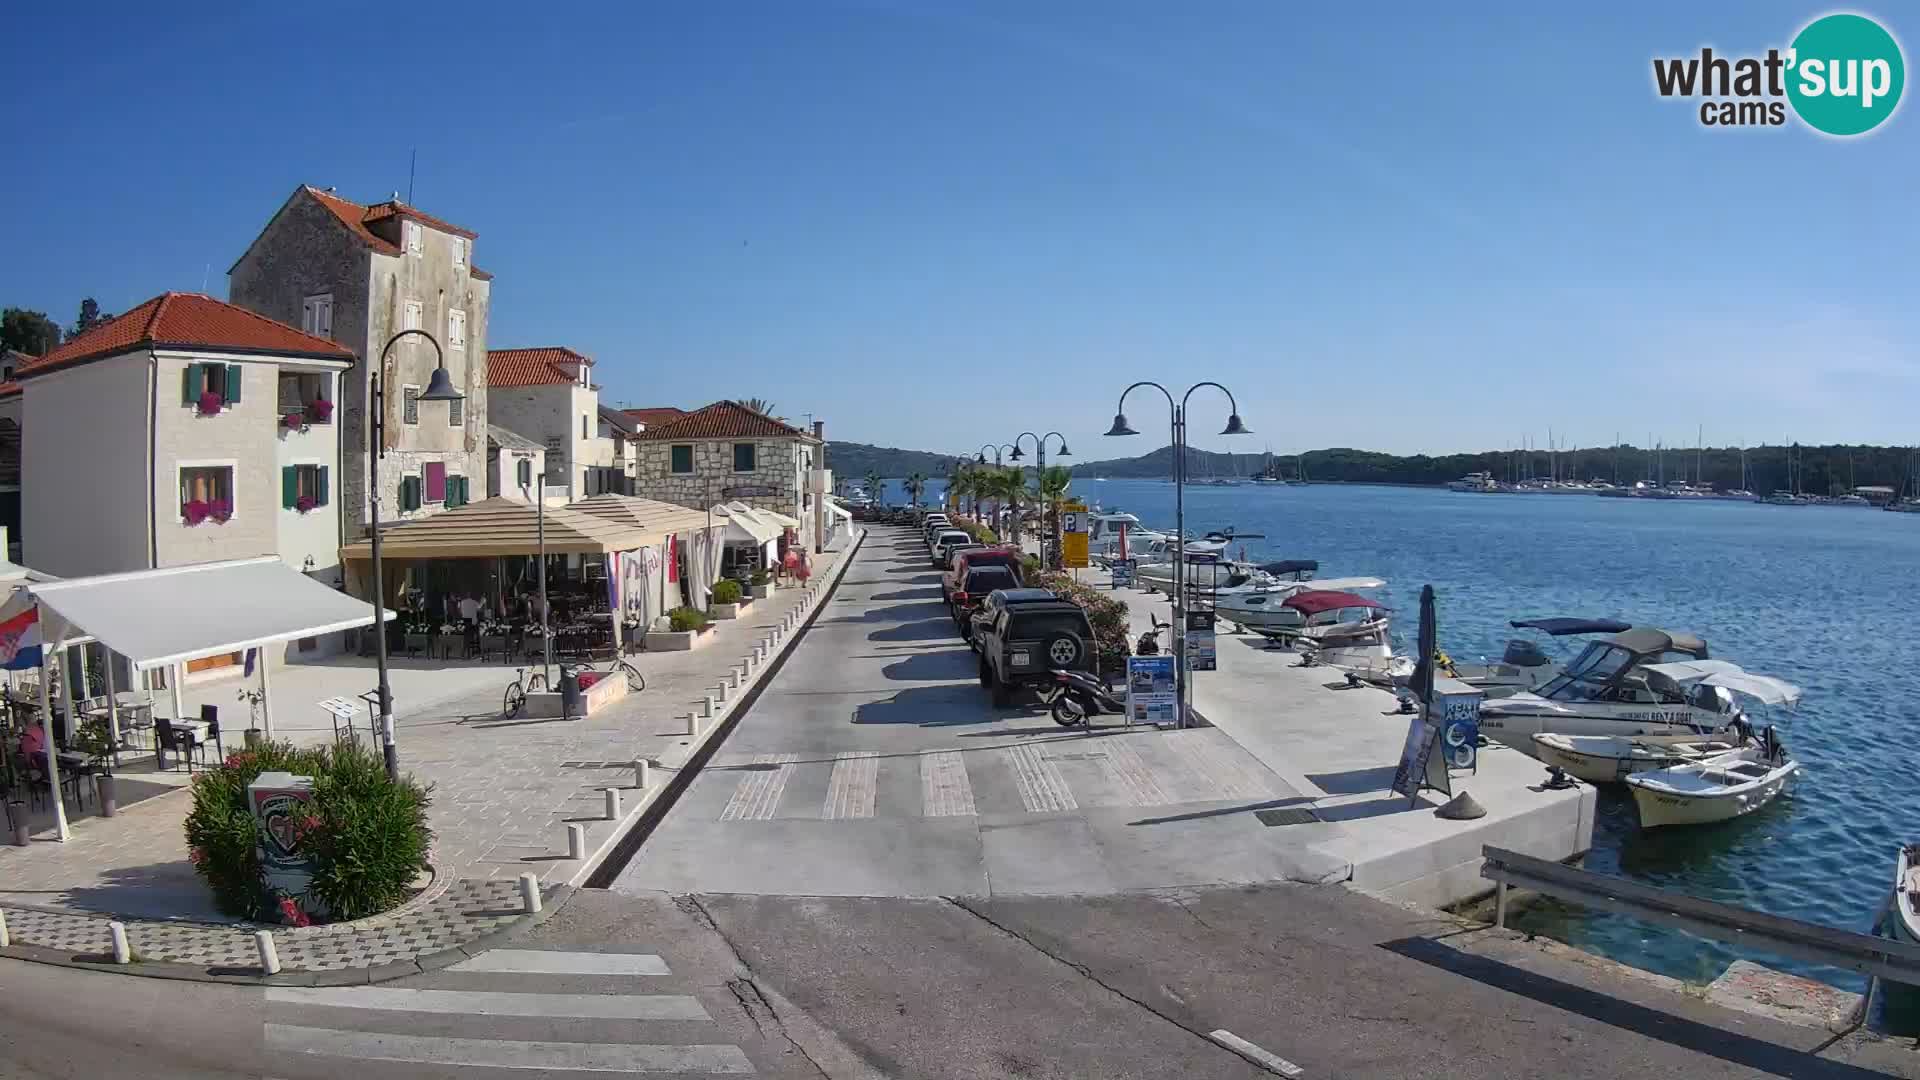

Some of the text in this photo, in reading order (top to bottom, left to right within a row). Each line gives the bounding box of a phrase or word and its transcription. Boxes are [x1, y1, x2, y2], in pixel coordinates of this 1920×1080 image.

[1064, 514, 1076, 531] P
[1447, 703, 1479, 712] RENT
[1650, 711, 1669, 721] RENT
